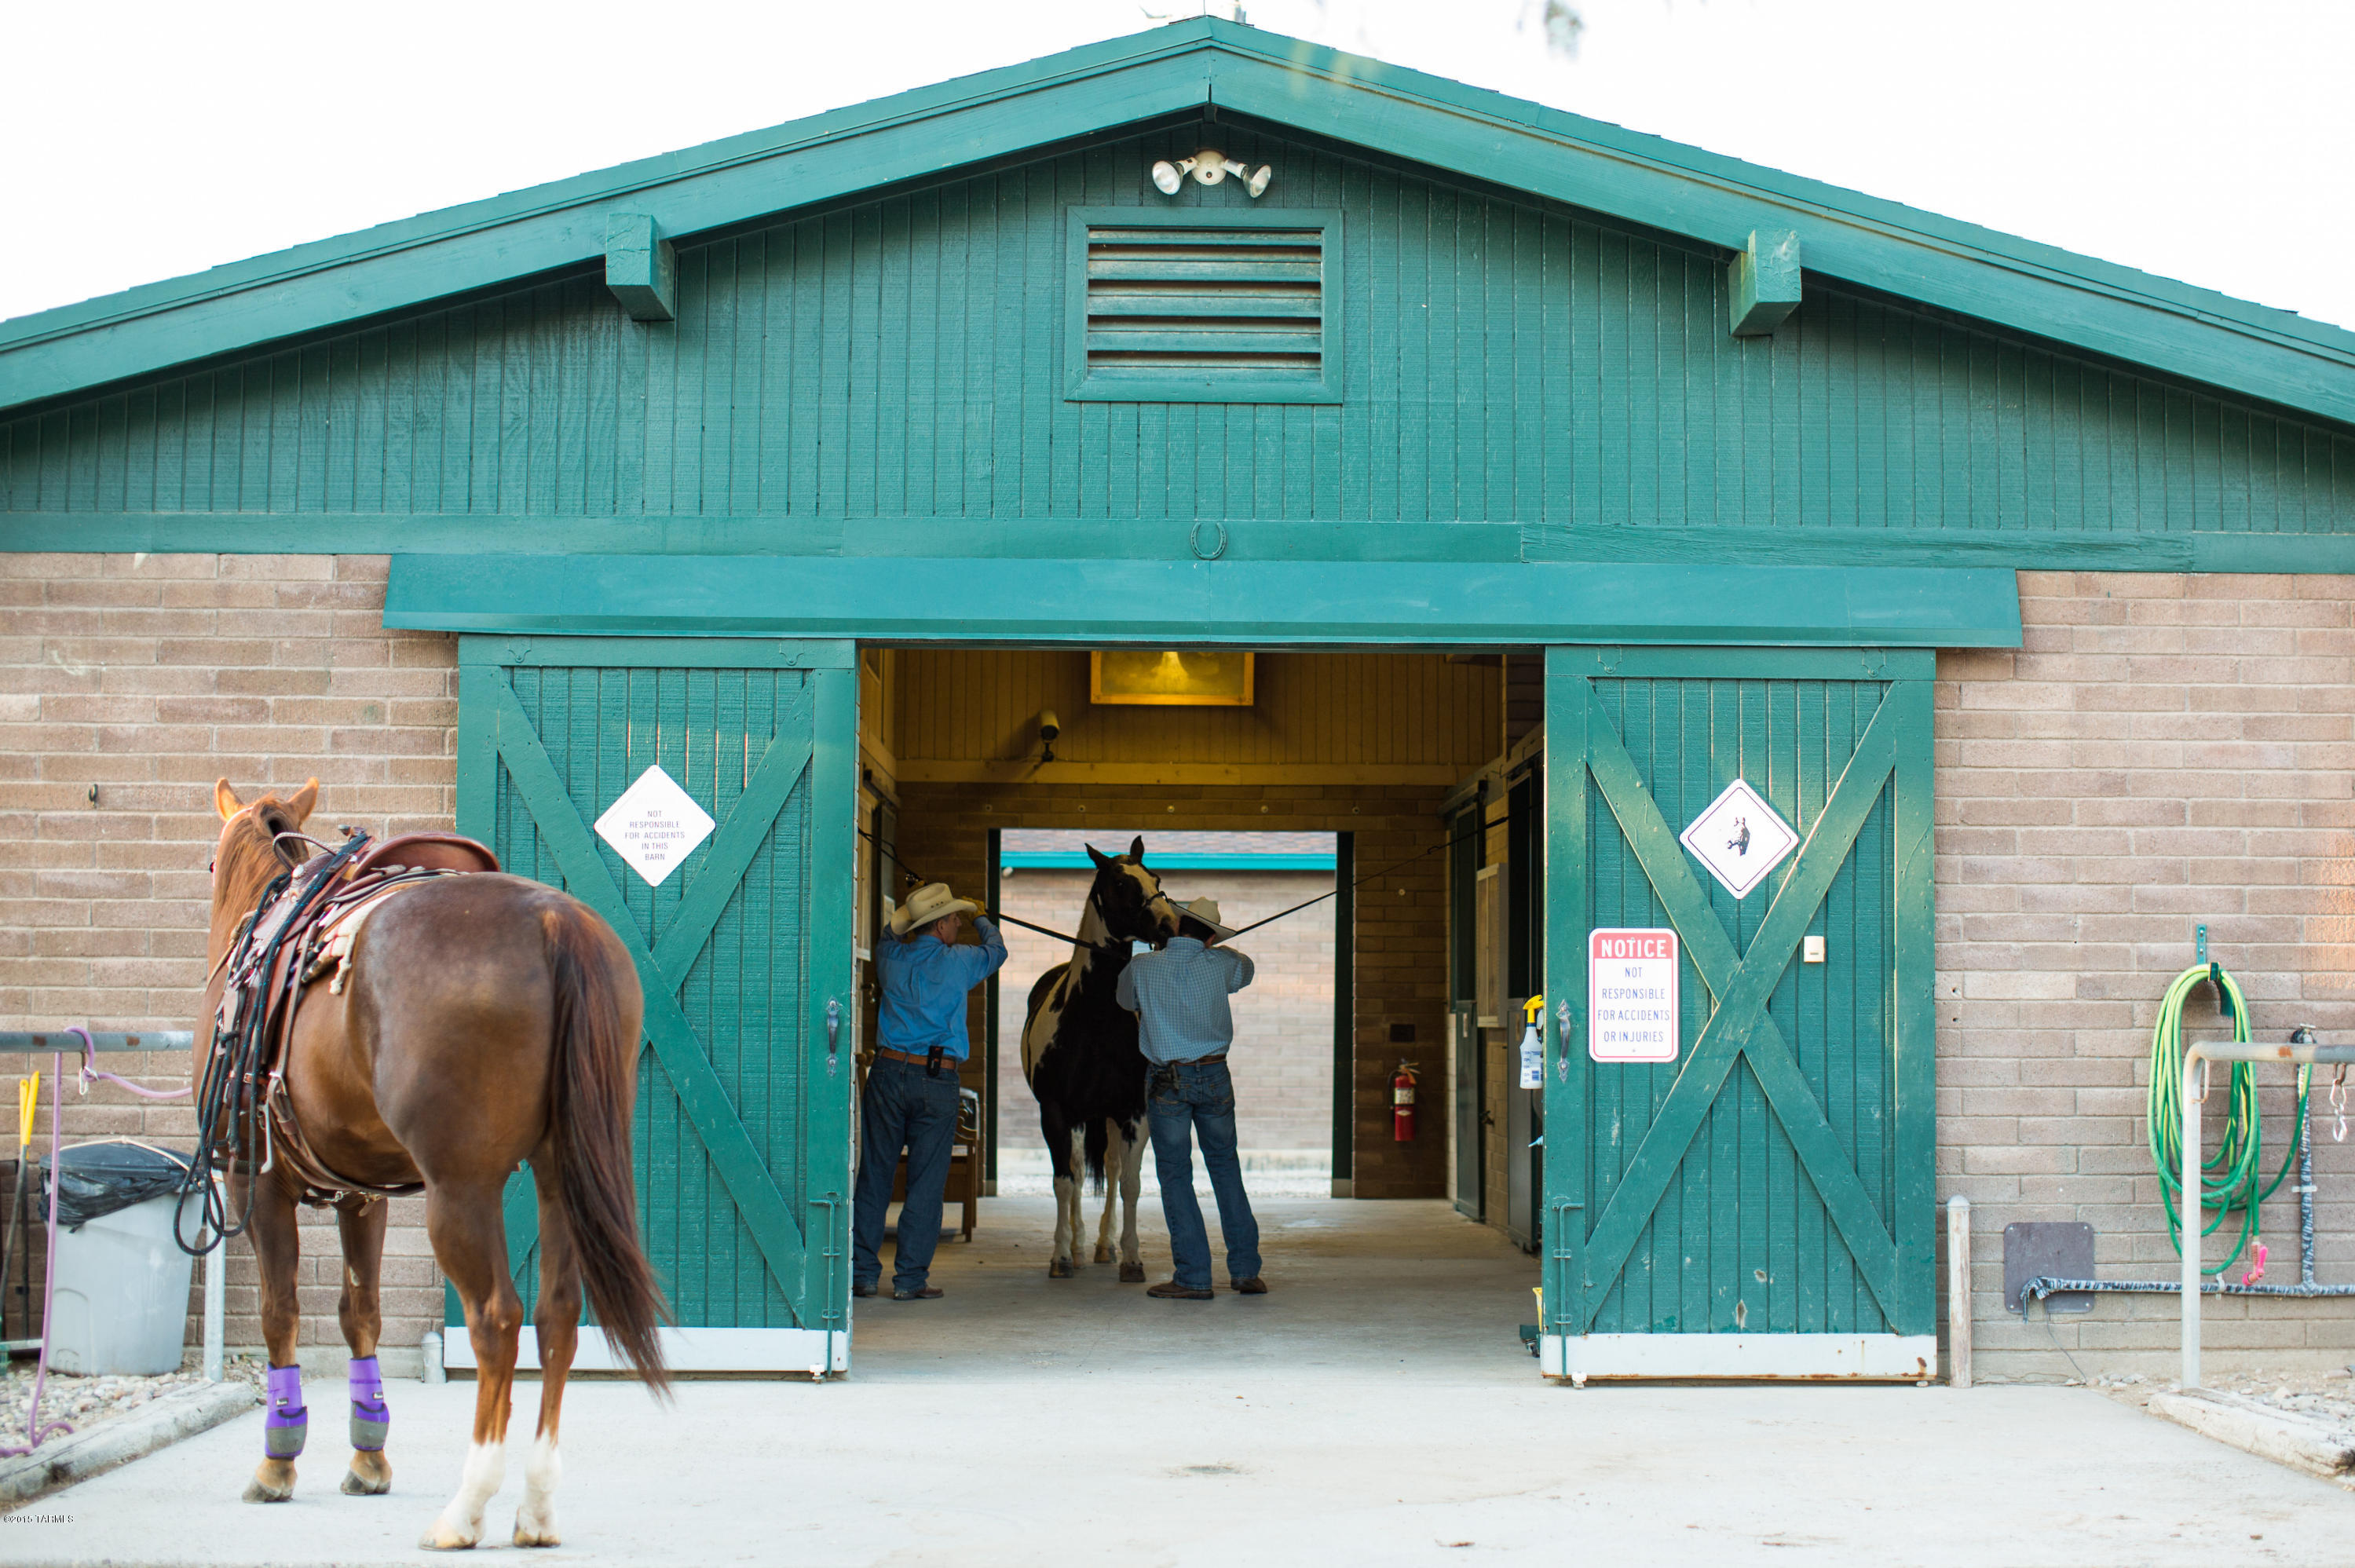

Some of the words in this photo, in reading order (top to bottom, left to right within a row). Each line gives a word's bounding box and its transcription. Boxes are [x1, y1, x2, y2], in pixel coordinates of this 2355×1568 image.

[1601, 938, 1667, 958] NOTICE
[1625, 967, 1643, 978] NOT
[1602, 988, 1666, 1000] RESPONSIBLE
[1597, 1010, 1615, 1021] FOR
[1618, 1010, 1670, 1021] ACCIDENTS
[1604, 1031, 1616, 1043] OR
[1618, 1031, 1664, 1043] INJURIES
